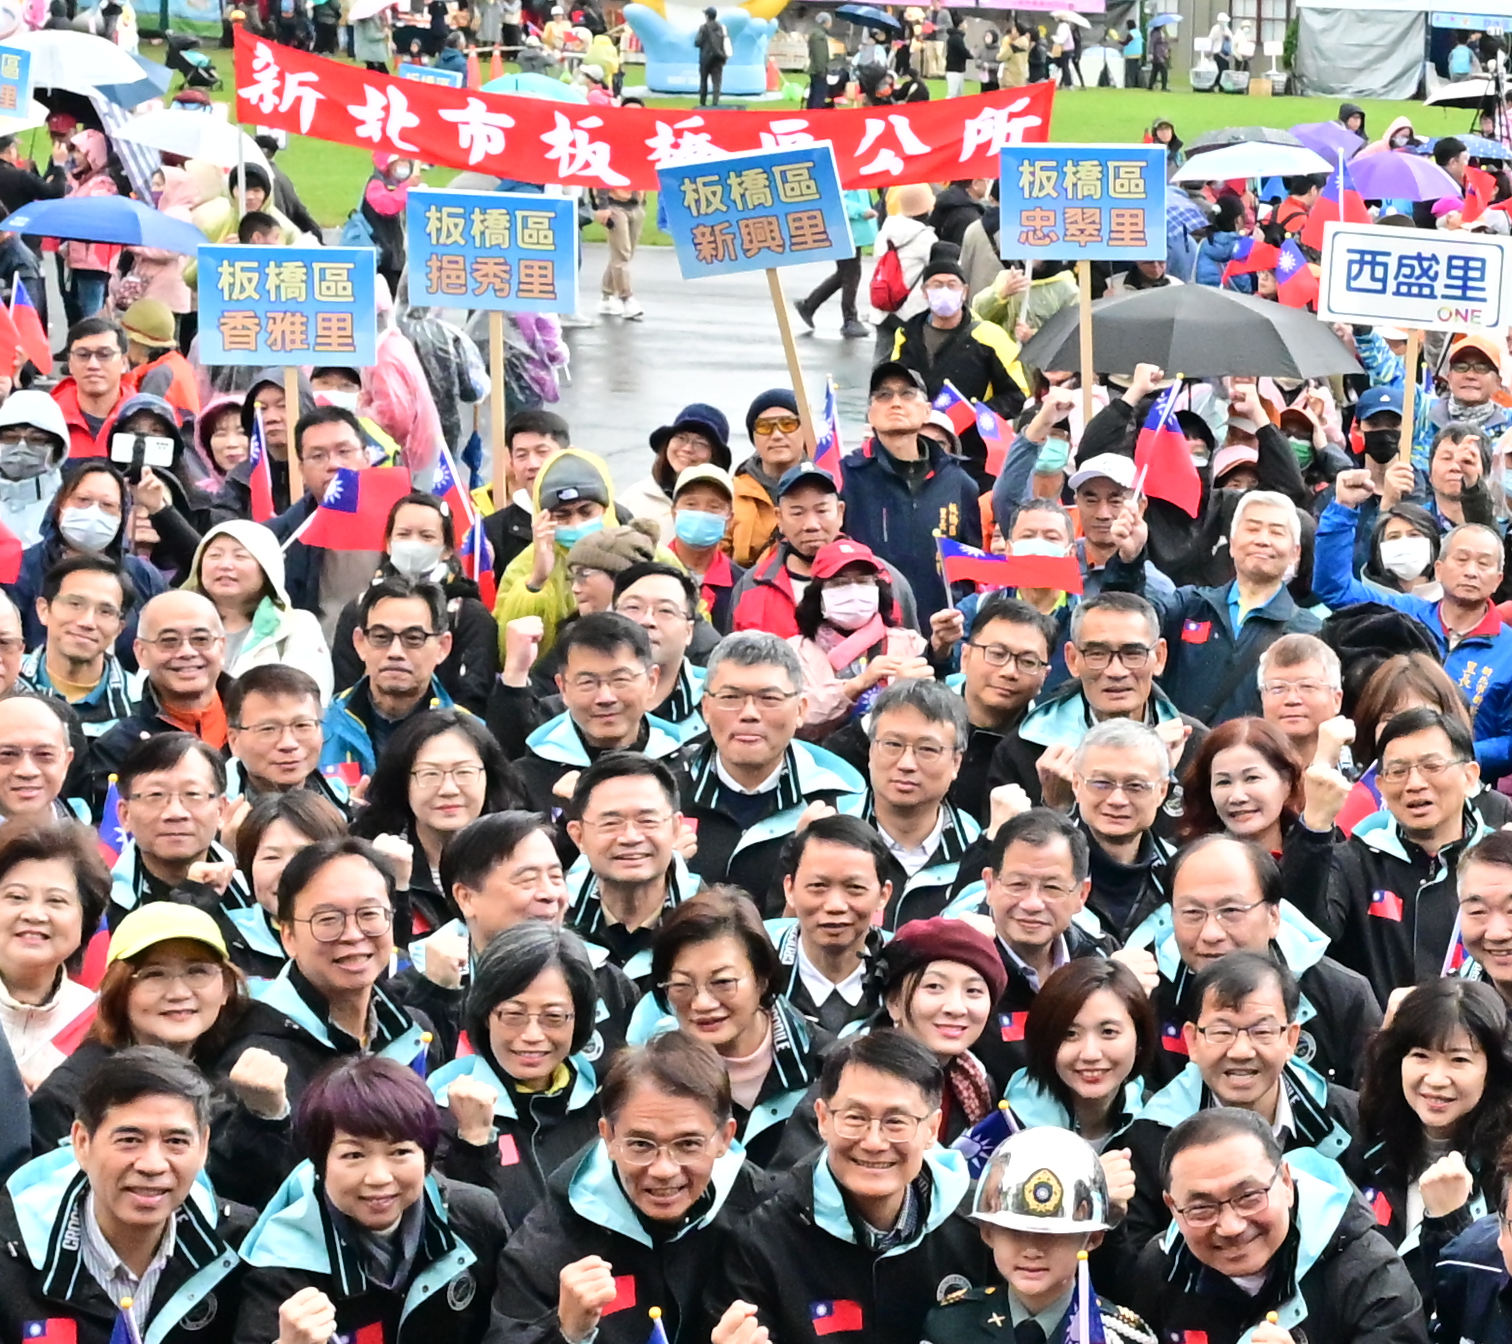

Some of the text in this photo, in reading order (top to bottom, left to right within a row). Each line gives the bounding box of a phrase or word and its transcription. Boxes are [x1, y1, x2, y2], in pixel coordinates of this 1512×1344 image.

[680, 161, 821, 217] 板橋區
[1018, 159, 1149, 200] 板橋區
[425, 205, 557, 251] 板橋區
[691, 208, 833, 264] 新興里
[1018, 206, 1149, 248] 忠翠里
[218, 260, 356, 303] 板橋區
[425, 253, 557, 301] 挹秀里
[1345, 248, 1488, 303] 西盛里
[218, 310, 356, 352] 香雅里
[1436, 306, 1483, 325] ONE
